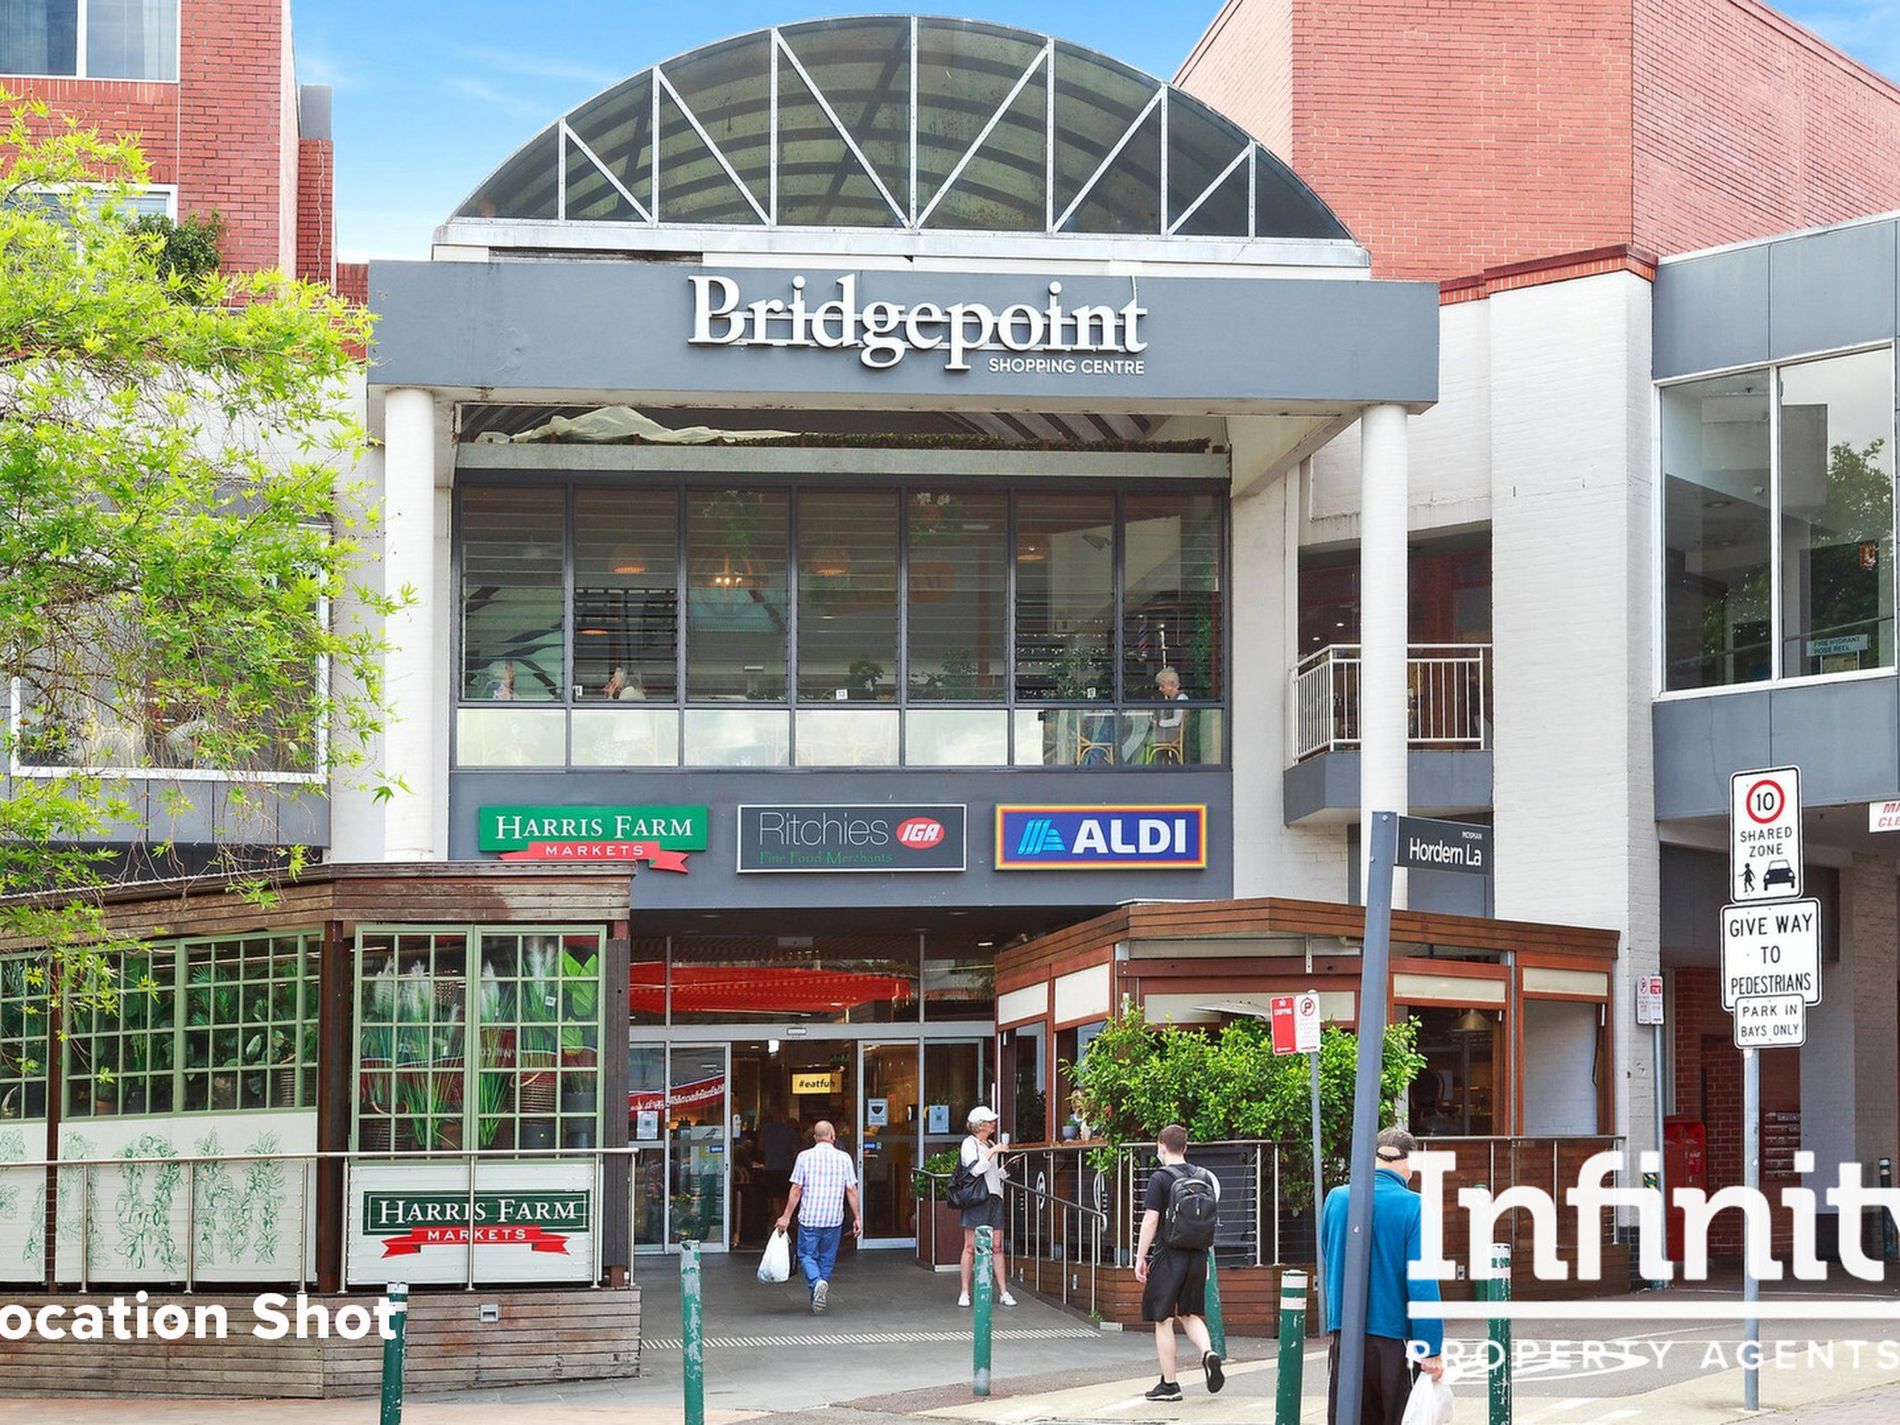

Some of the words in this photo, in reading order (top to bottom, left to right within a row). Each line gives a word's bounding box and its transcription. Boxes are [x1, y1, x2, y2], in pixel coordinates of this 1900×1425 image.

[687, 273, 1148, 371] Bridgepoint
[988, 357, 1076, 374] SHOPPING
[1081, 359, 1145, 375] CENTRE
[1756, 791, 1775, 812] 10
[495, 815, 603, 840] HARRIS
[614, 814, 693, 839] FARM
[759, 811, 889, 846] Ritchies
[901, 823, 942, 842] IGA
[1071, 818, 1187, 854] ALDI
[1740, 826, 1793, 843] SHARED
[545, 845, 644, 856] MARKETS
[760, 851, 786, 865] Fine
[789, 850, 821, 865] Food
[826, 850, 893, 865] Merchants
[1409, 837, 1464, 865] Hordern
[1466, 843, 1482, 867] La
[1749, 843, 1784, 858] ZONE
[1729, 916, 1768, 938] GIVE
[1775, 913, 1813, 934] WAY
[1760, 945, 1781, 964] TO
[1731, 972, 1812, 996] PEDESTRIANS
[1742, 1004, 1777, 1018] PARK
[1785, 1004, 1798, 1016] IN
[1741, 1024, 1767, 1038] BAYS
[1773, 1023, 1799, 1036] ONLY
[378, 1200, 486, 1225] HARRIS
[498, 1198, 576, 1223] FARM
[427, 1228, 526, 1241] MARKETS
